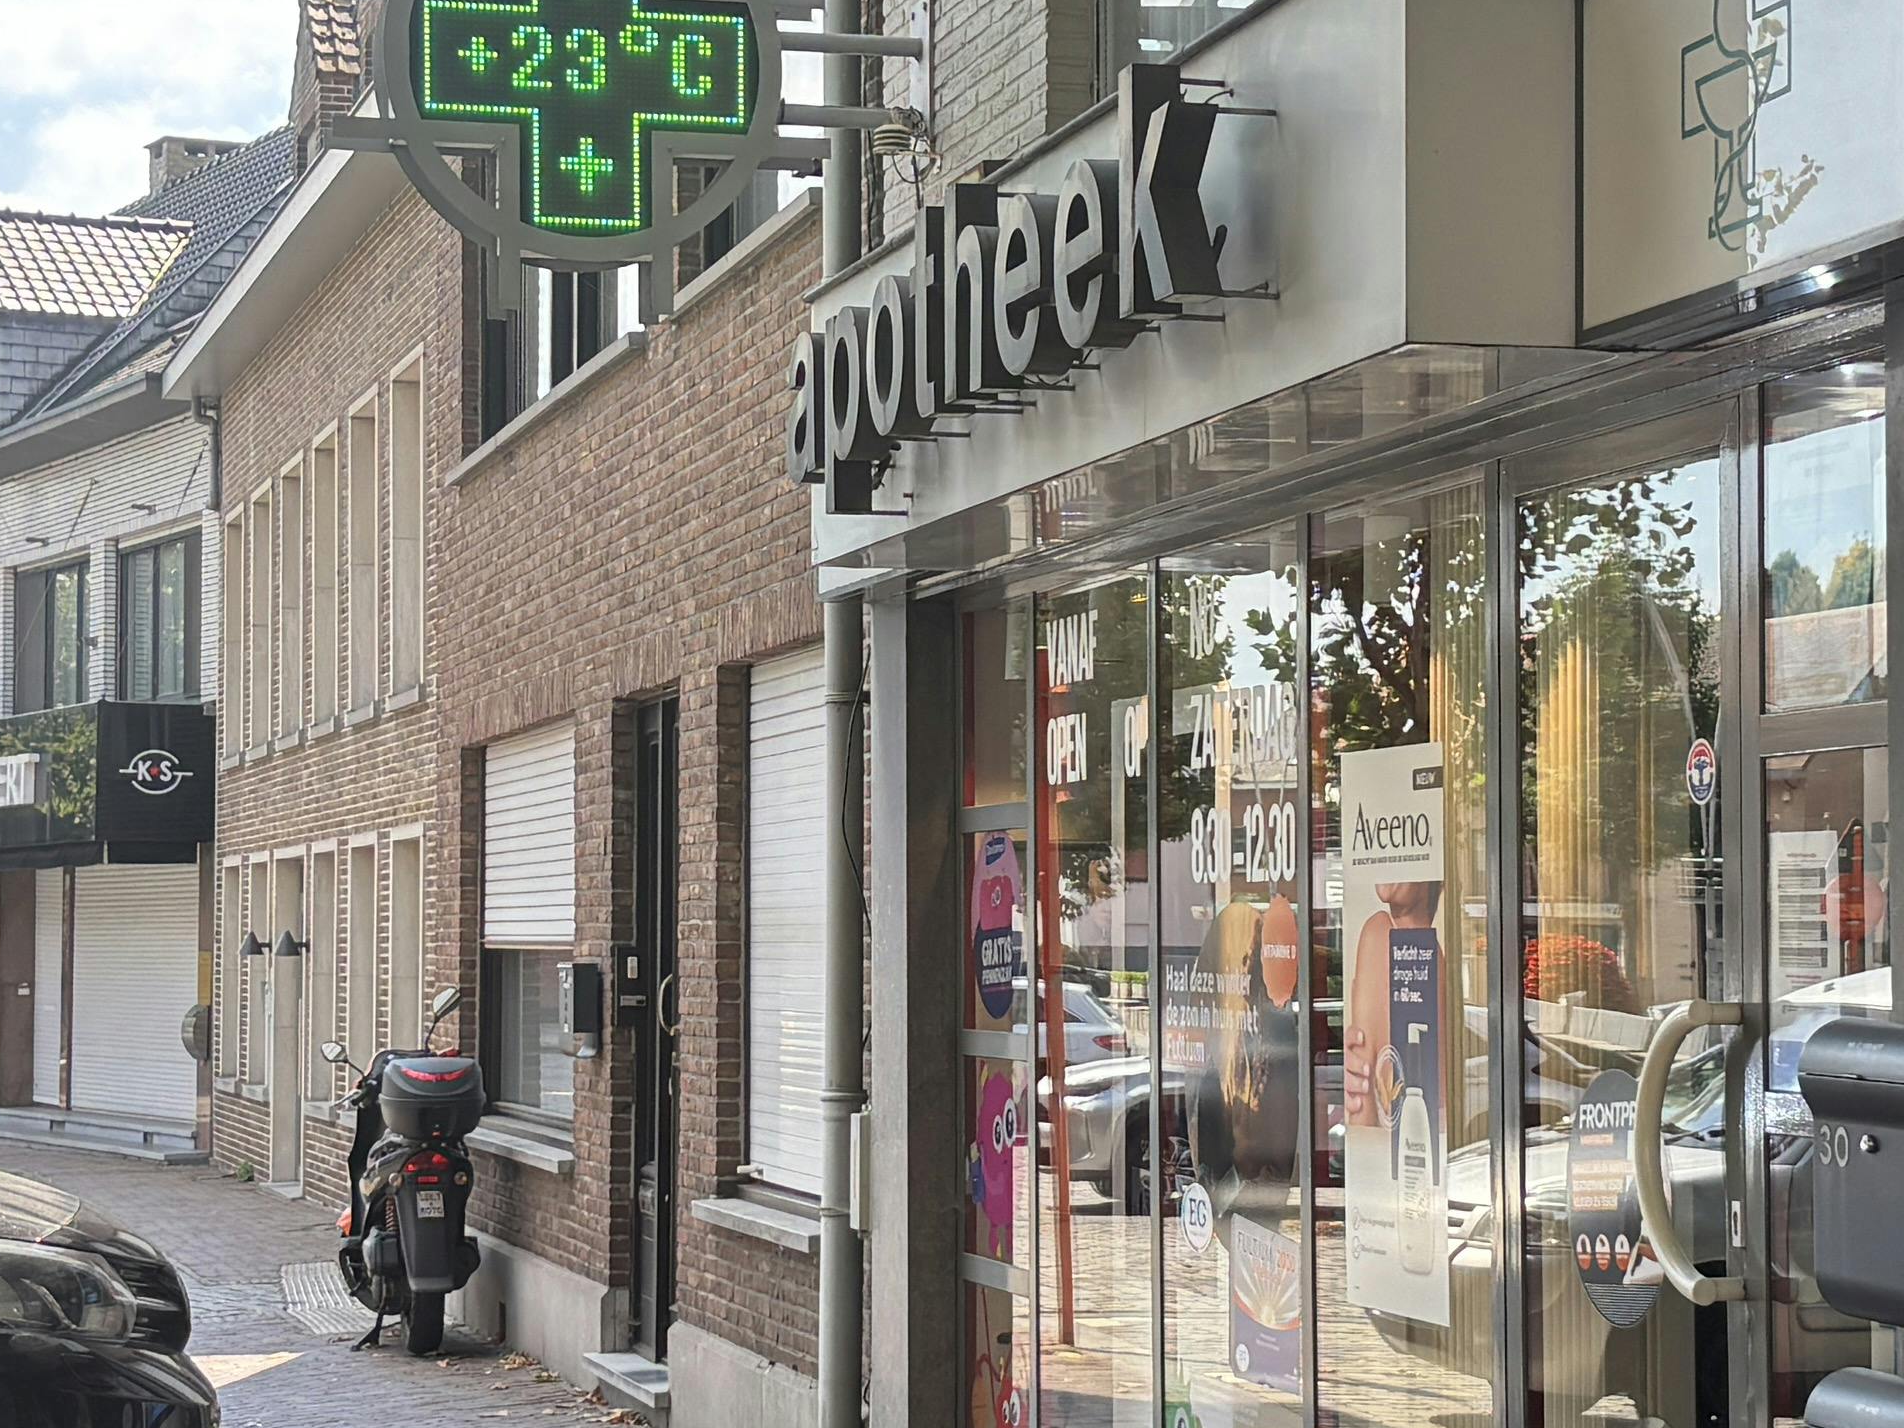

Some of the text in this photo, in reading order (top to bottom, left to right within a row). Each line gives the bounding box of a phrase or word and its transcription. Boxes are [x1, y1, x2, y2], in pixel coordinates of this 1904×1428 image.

[786, 64, 1222, 514] apotheek
[1046, 609, 1098, 688] VANAF
[1047, 712, 1087, 786] OPEN
[1190, 681, 1296, 769] ZATERDAG
[1166, 963, 1189, 992] Haal
[1819, 1124, 1849, 1168] 30
[1189, 1198, 1207, 1228] EG
